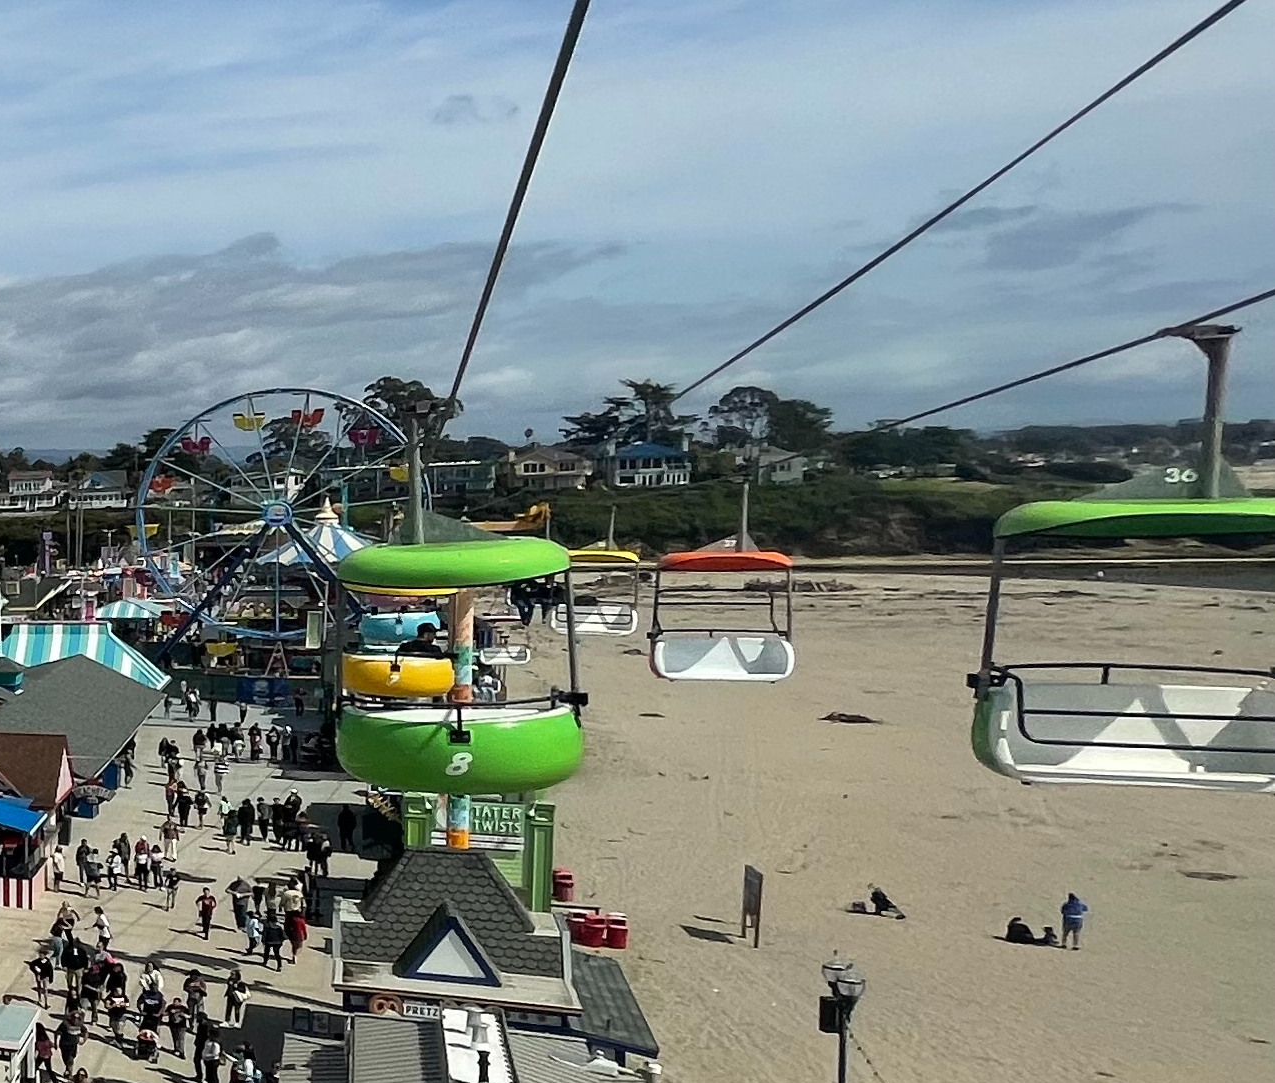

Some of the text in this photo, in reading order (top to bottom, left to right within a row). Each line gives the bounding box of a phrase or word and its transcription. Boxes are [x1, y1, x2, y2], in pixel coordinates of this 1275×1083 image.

[1164, 467, 1199, 483] 36
[445, 752, 473, 776] 8
[473, 805, 523, 820] TATER
[473, 819, 522, 834] TWISTS
